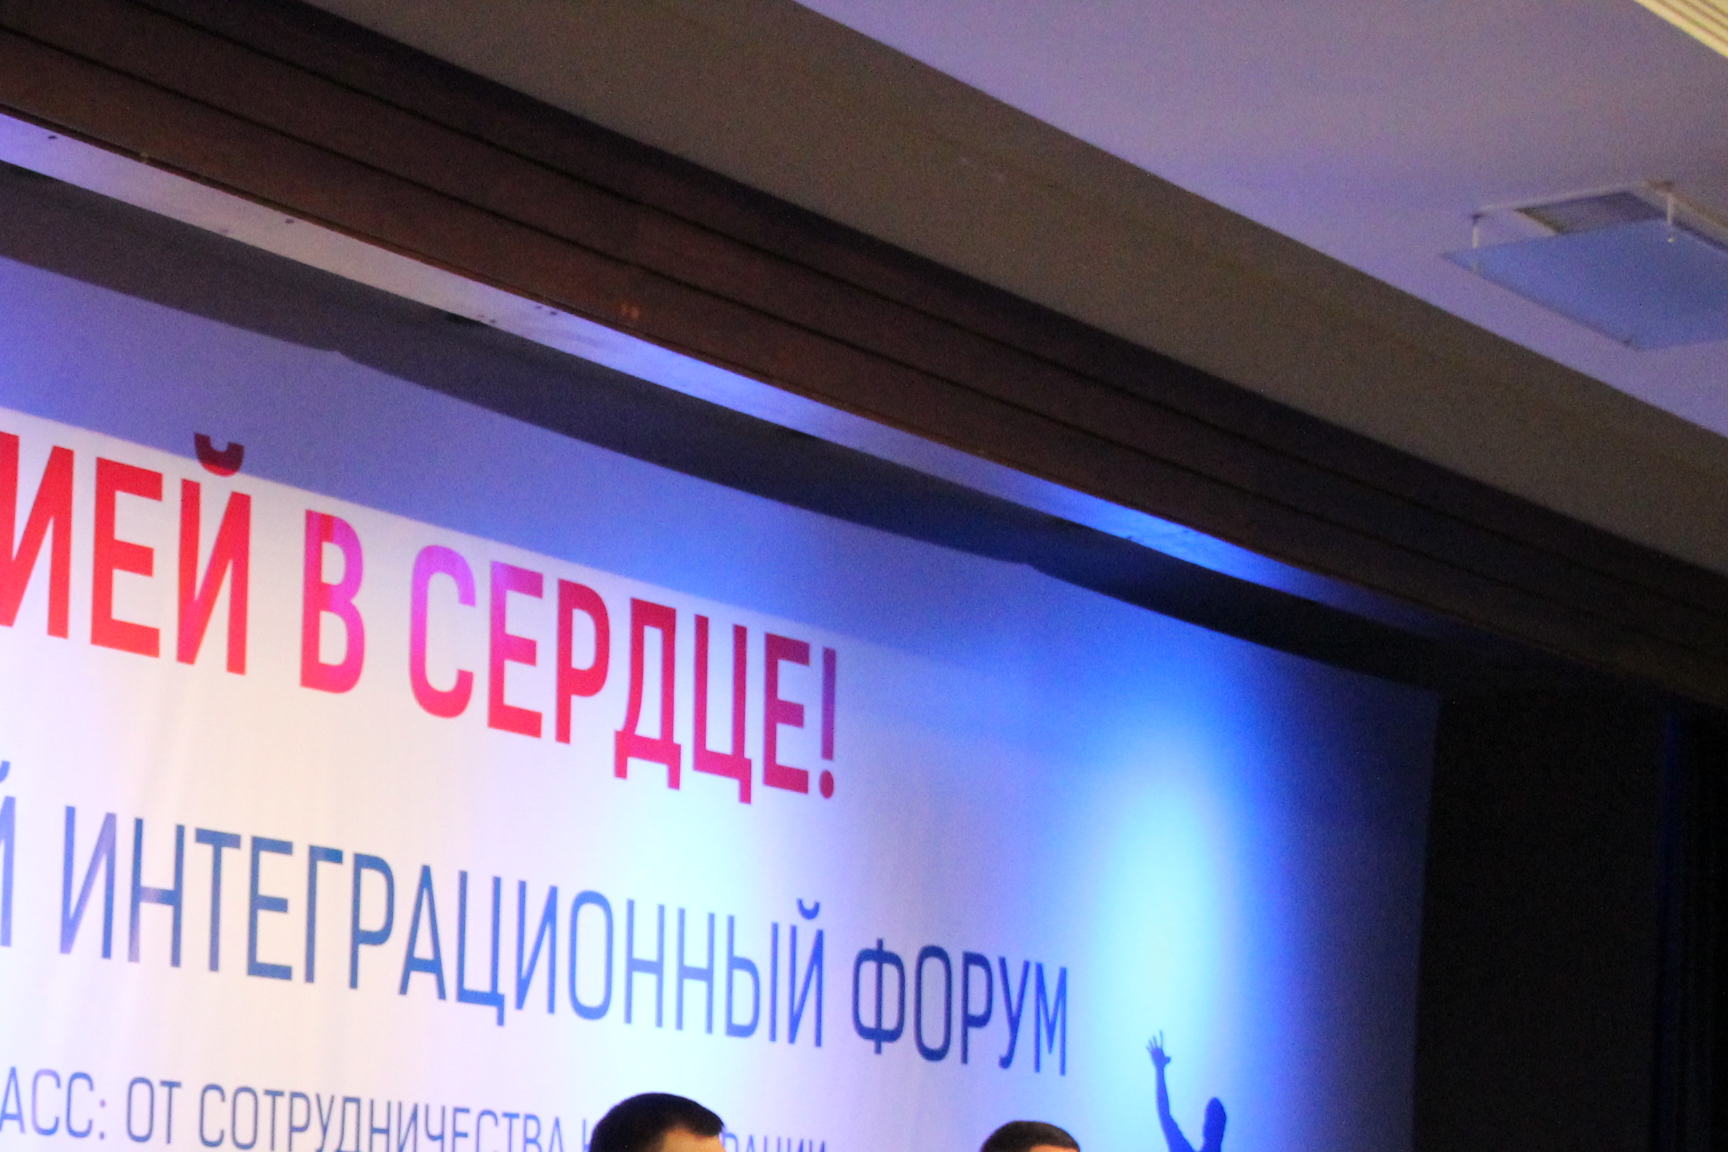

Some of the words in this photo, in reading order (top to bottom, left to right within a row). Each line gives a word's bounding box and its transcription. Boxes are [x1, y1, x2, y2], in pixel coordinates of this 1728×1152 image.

[299, 508, 366, 694] В
[408, 544, 837, 806] СЕРДЦЕ!
[58, 805, 825, 1048] ИНТЕГРАЦИОННЫЙ
[851, 938, 1068, 1077] ФОРУМ
[126, 1076, 183, 1145] ОТ
